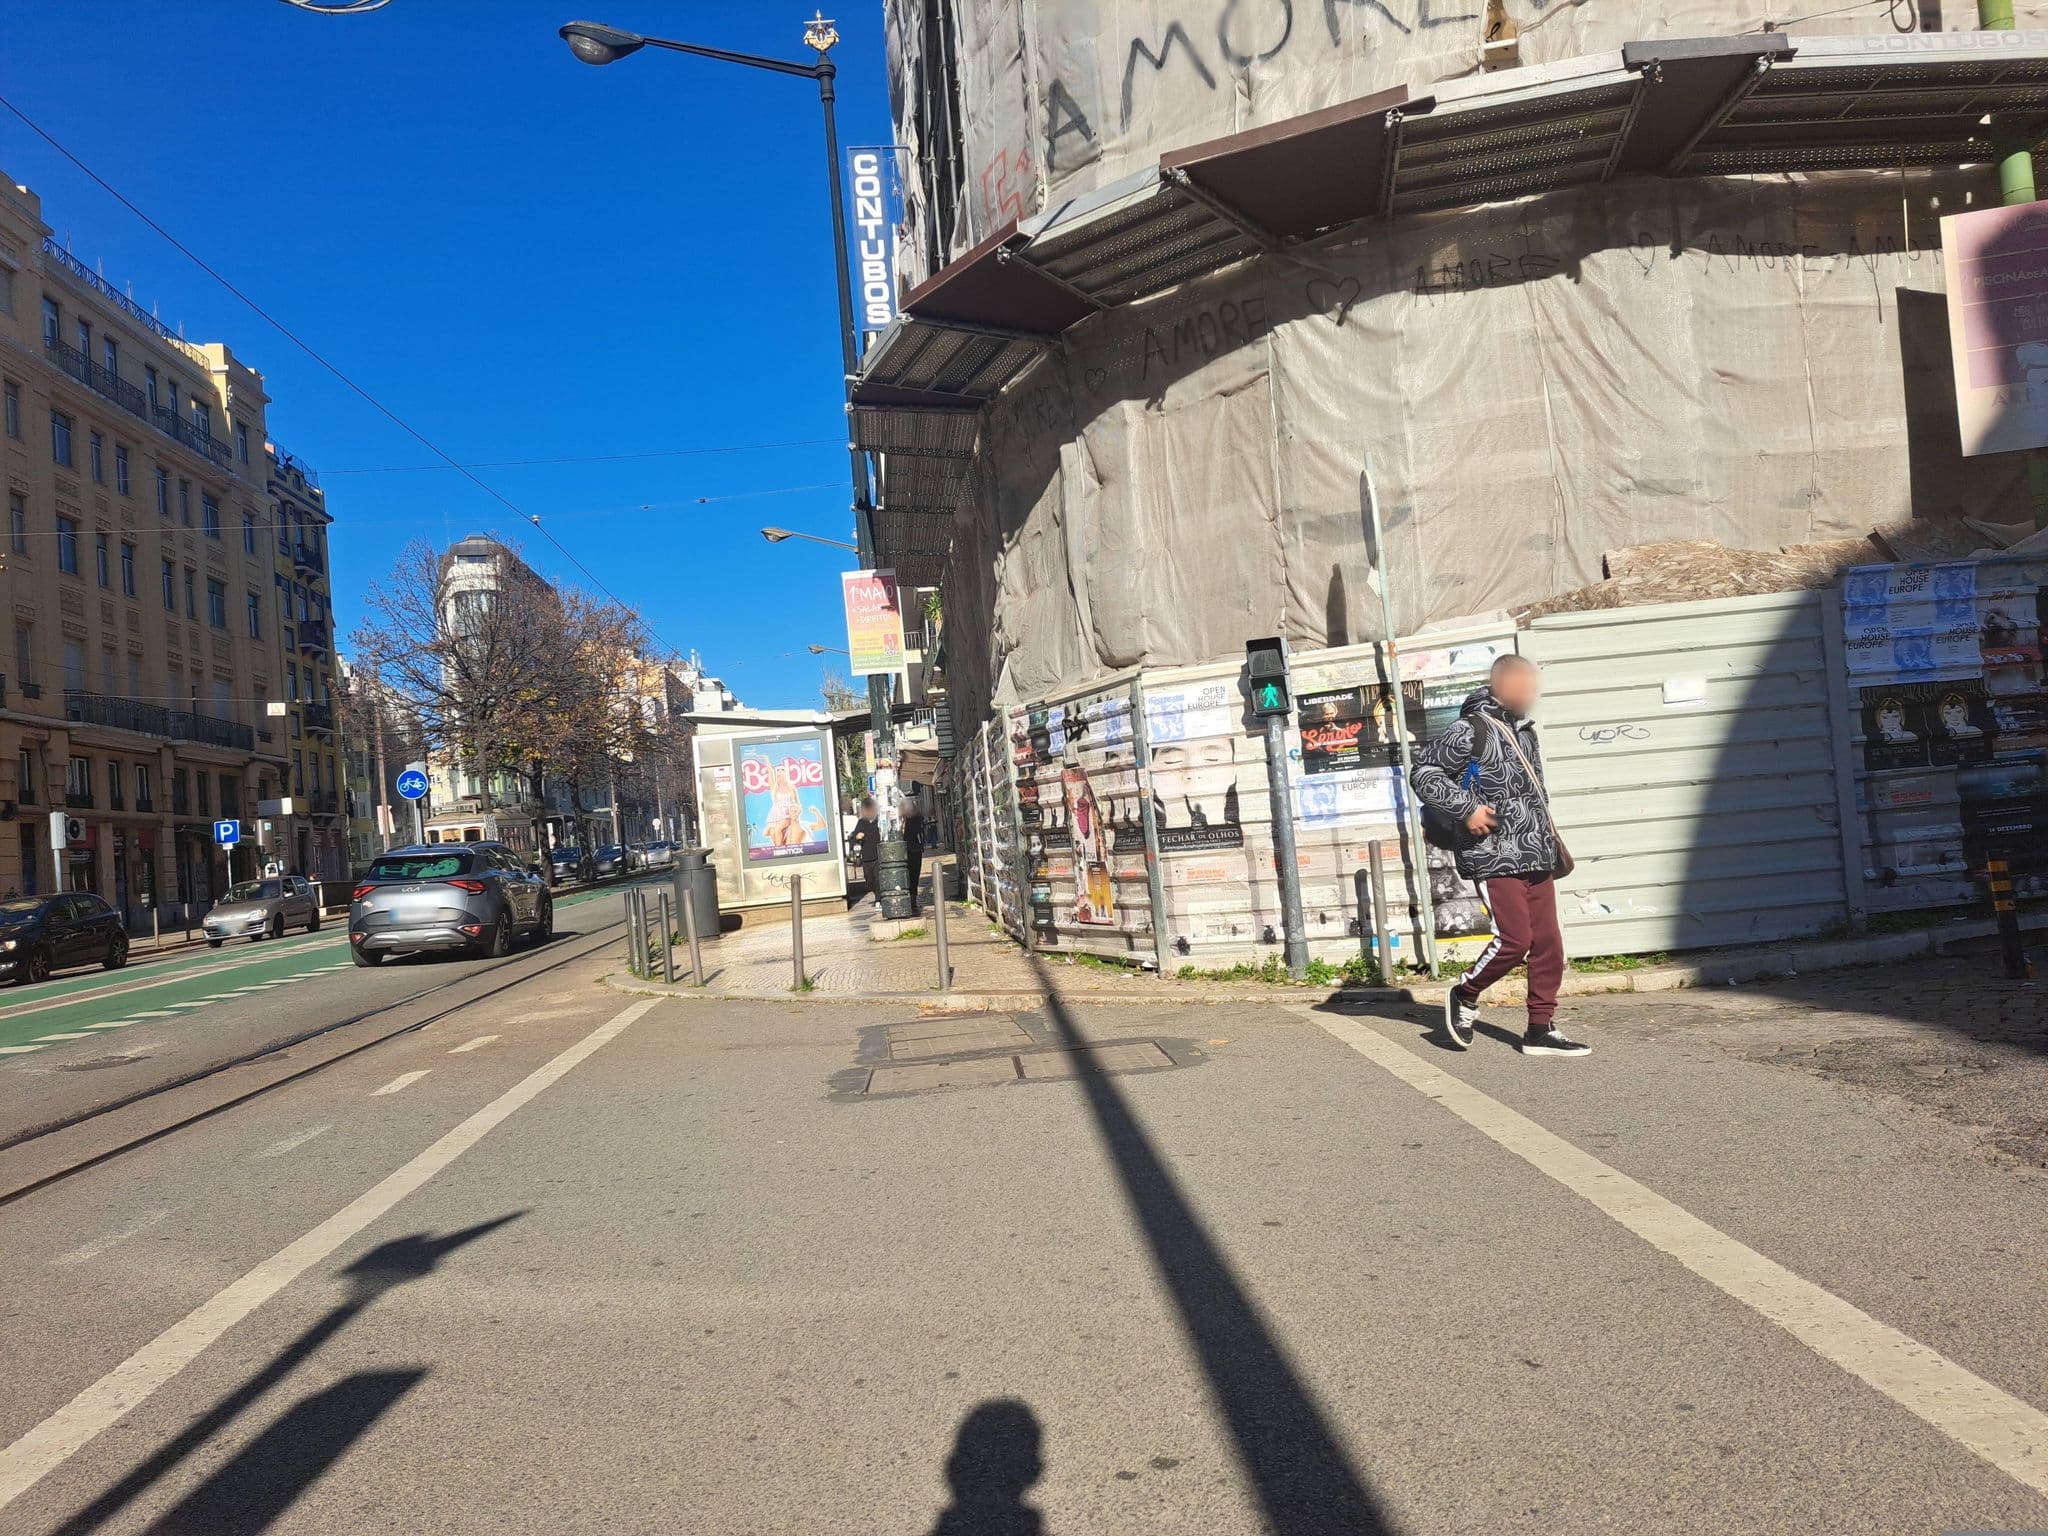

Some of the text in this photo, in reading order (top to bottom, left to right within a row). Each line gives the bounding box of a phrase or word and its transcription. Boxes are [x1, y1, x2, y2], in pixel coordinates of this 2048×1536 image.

[853, 153, 893, 326] CONTUBOS
[1415, 253, 1560, 307] AMORE
[1141, 296, 1266, 381] AMORE
[1904, 567, 1930, 577] OPEN
[1899, 575, 1930, 586] HOUSE
[1888, 583, 1924, 595] EUROPE
[1861, 632, 1892, 642] HOUSE
[1847, 640, 1885, 651] EUROPE
[1202, 686, 1226, 696] OPEN
[1198, 693, 1225, 702] HOUSE
[1187, 701, 1220, 711] EUROPE
[741, 757, 823, 791] Babie
[1342, 780, 1378, 792] EUROPE
[219, 823, 234, 842] P
[1161, 834, 1197, 843] FECHAR
[1208, 830, 1240, 840] OLHOS
